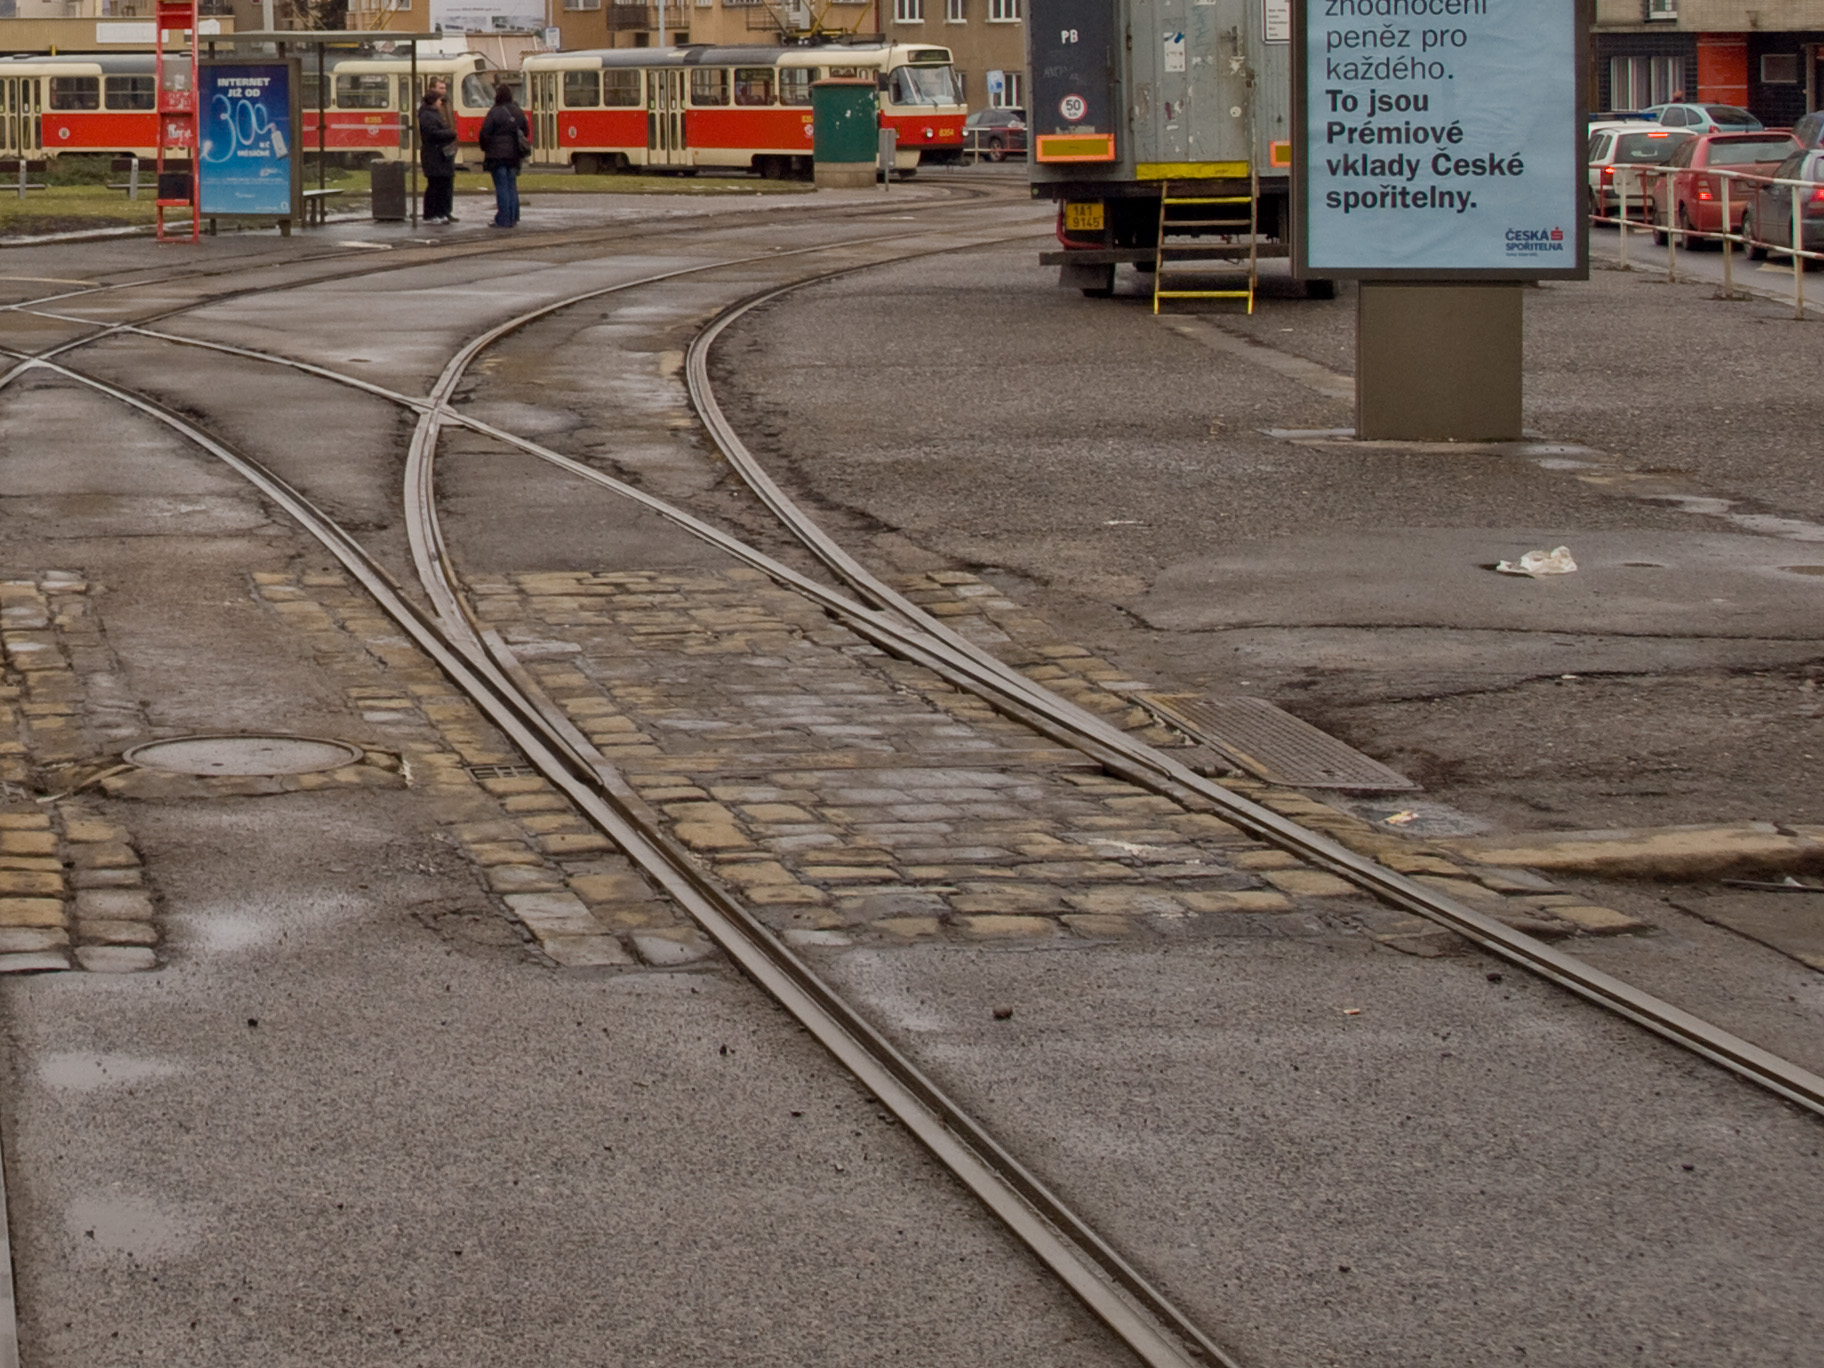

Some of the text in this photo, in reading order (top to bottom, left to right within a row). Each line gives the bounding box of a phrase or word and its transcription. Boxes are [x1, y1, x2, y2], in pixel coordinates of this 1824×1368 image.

[1061, 29, 1079, 44] PB
[1327, 24, 1467, 53] peněz pro
[1326, 55, 1454, 81] každého.
[217, 78, 271, 87] INTERNET
[1065, 99, 1082, 111] 50
[1326, 89, 1429, 117] To jsou
[1327, 119, 1463, 145] Prémiové
[1327, 147, 1524, 181] vklady České
[1326, 184, 1477, 214] spořitelny.
[1505, 228, 1549, 241] ČESKÁ
[1506, 242, 1564, 251] SPOŘITELNA
